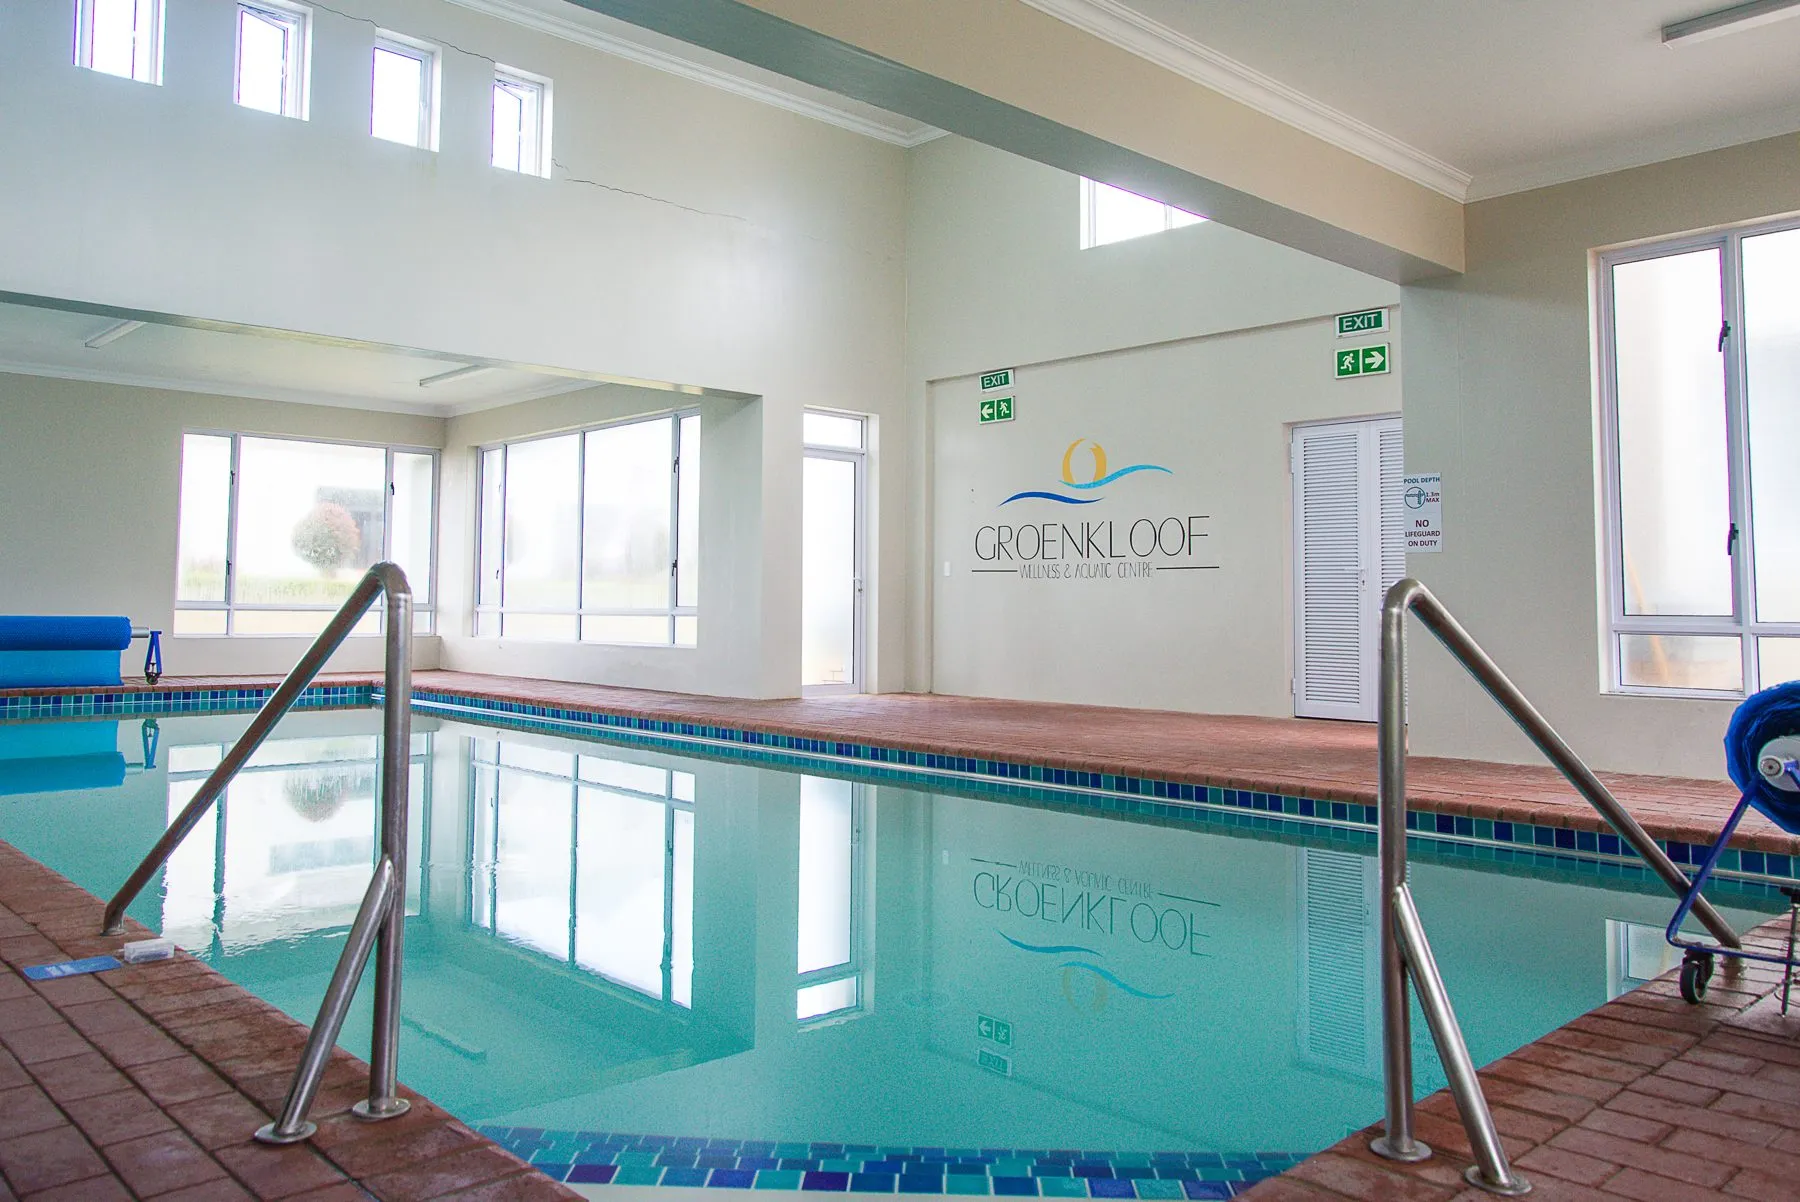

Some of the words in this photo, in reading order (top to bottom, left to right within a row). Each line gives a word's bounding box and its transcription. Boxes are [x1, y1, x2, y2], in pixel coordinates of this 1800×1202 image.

[1343, 313, 1378, 331] EXIT
[984, 374, 1006, 388] EXIT
[1415, 519, 1429, 528] NO
[975, 516, 1209, 560] GROENKLOOF
[1405, 530, 1440, 538] LIFEGUARD
[1419, 539, 1438, 547] DUTY
[1019, 563, 1061, 579] WELLNESS
[1075, 562, 1111, 579] AQUATIC
[1117, 561, 1153, 578] CENTRE
